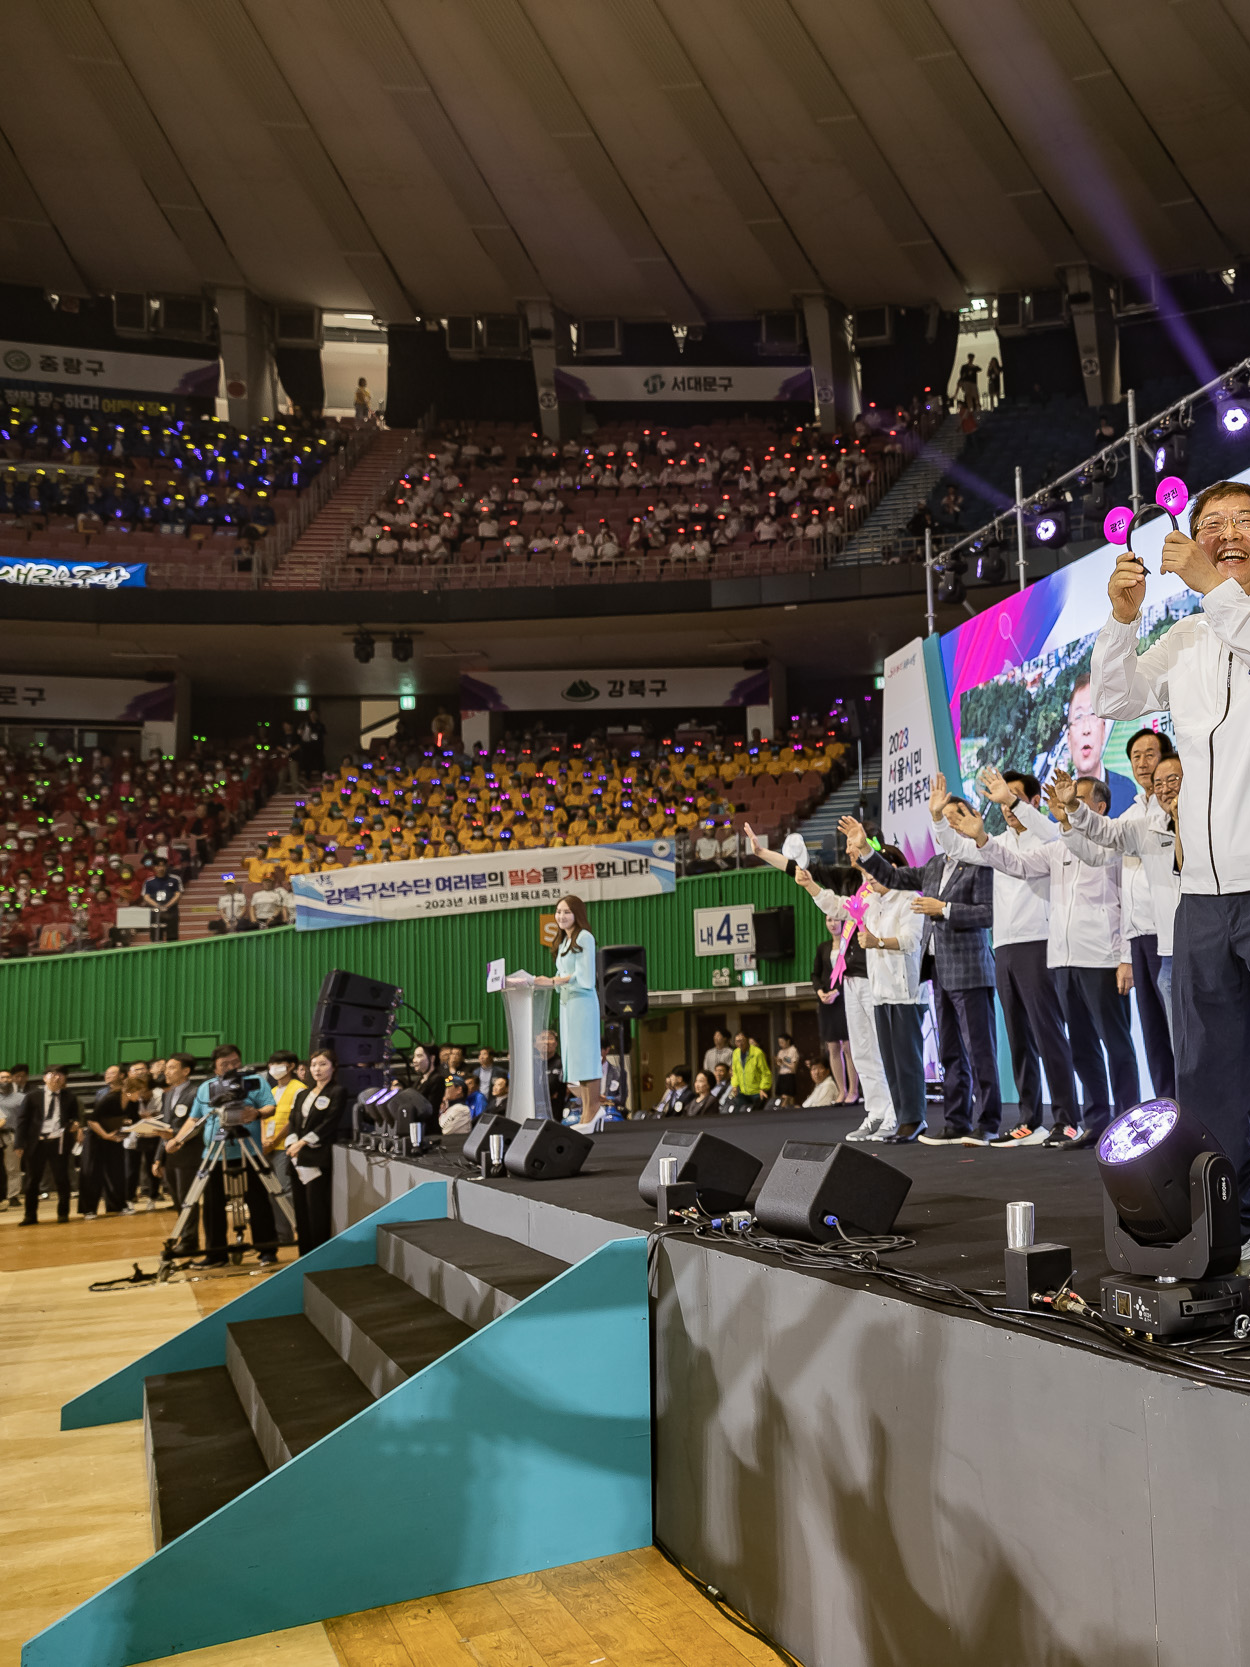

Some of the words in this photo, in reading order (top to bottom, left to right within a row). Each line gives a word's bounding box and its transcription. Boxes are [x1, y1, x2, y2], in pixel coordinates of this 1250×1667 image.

[39, 354, 105, 377] 중랑구
[671, 375, 733, 393] 서대문구
[1163, 488, 1178, 504] 광진
[1109, 518, 1125, 533] 광진
[606, 680, 667, 697] 강북구
[888, 727, 909, 756] 2023
[888, 748, 922, 784] 서울시민
[887, 775, 931, 815] 체육대축전
[324, 878, 431, 905] 강북구선수단
[435, 871, 504, 892] 여러분의
[508, 866, 558, 887] 필승을
[562, 858, 649, 881] 기원합니다!
[424, 896, 463, 910] 2023년
[467, 888, 561, 906] 서울시민체육대축전
